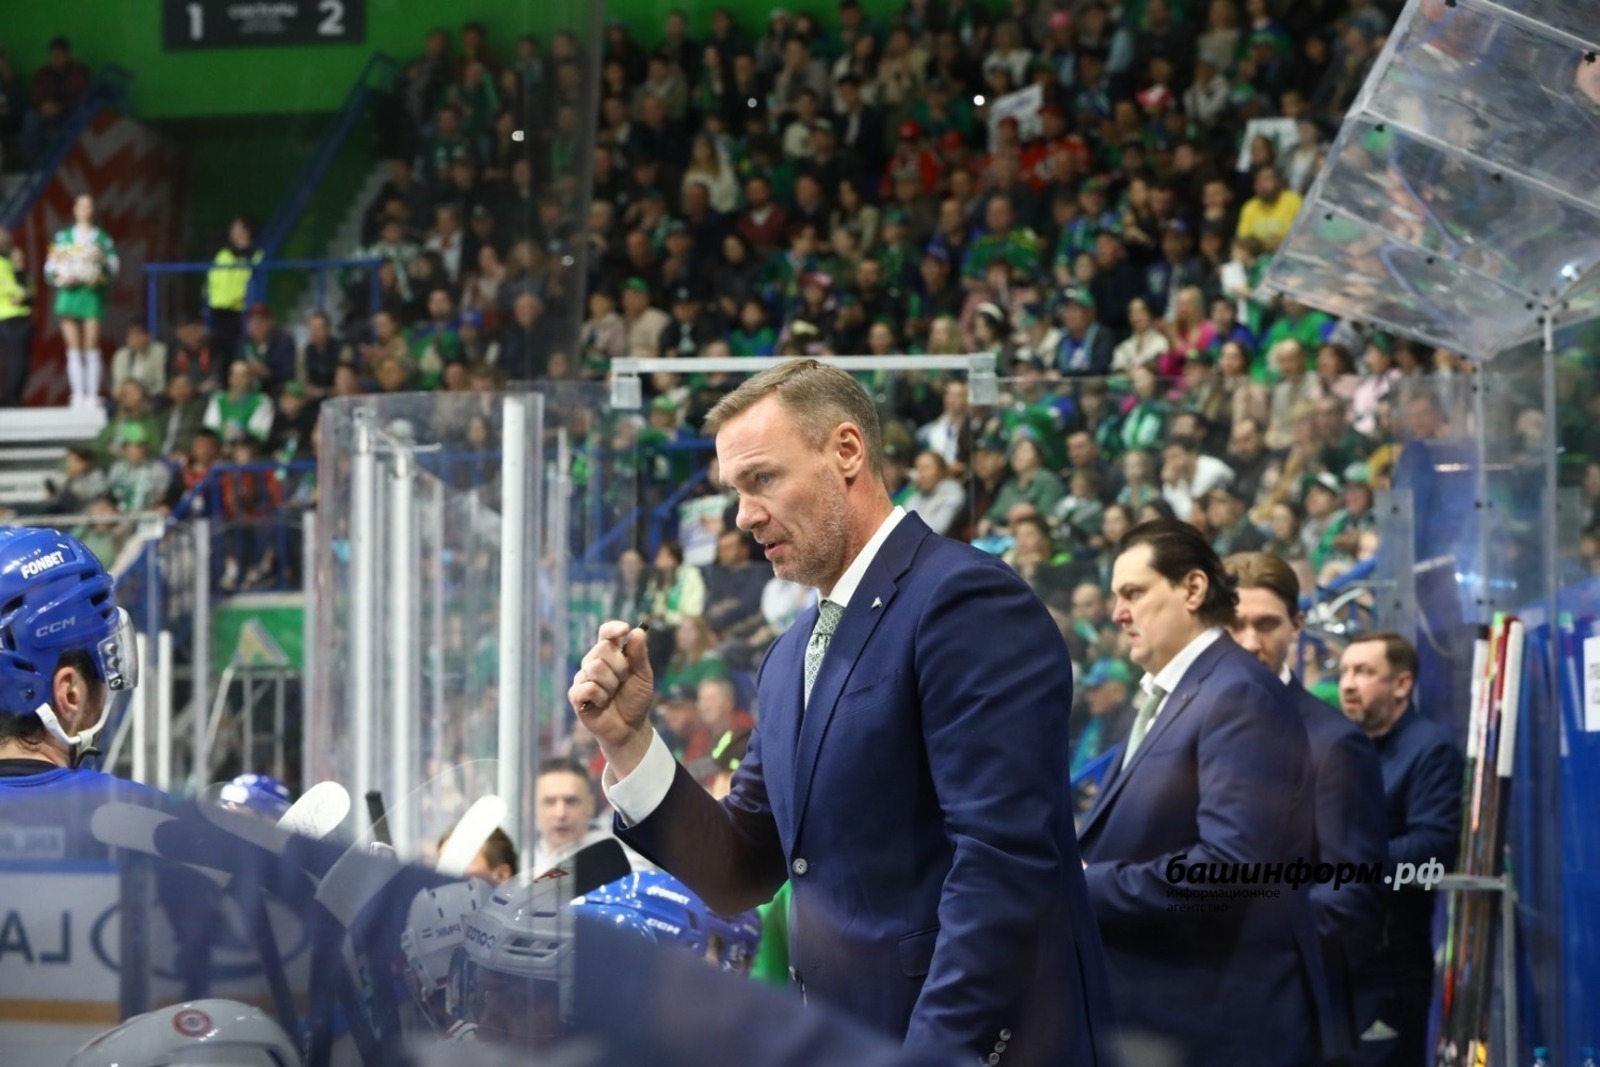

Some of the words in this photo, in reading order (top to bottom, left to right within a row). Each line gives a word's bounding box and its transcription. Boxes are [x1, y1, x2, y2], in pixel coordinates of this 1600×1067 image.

[186, 2, 204, 40] 1
[317, 0, 346, 35] 2
[20, 551, 65, 579] FONBET
[35, 616, 76, 638] CCM
